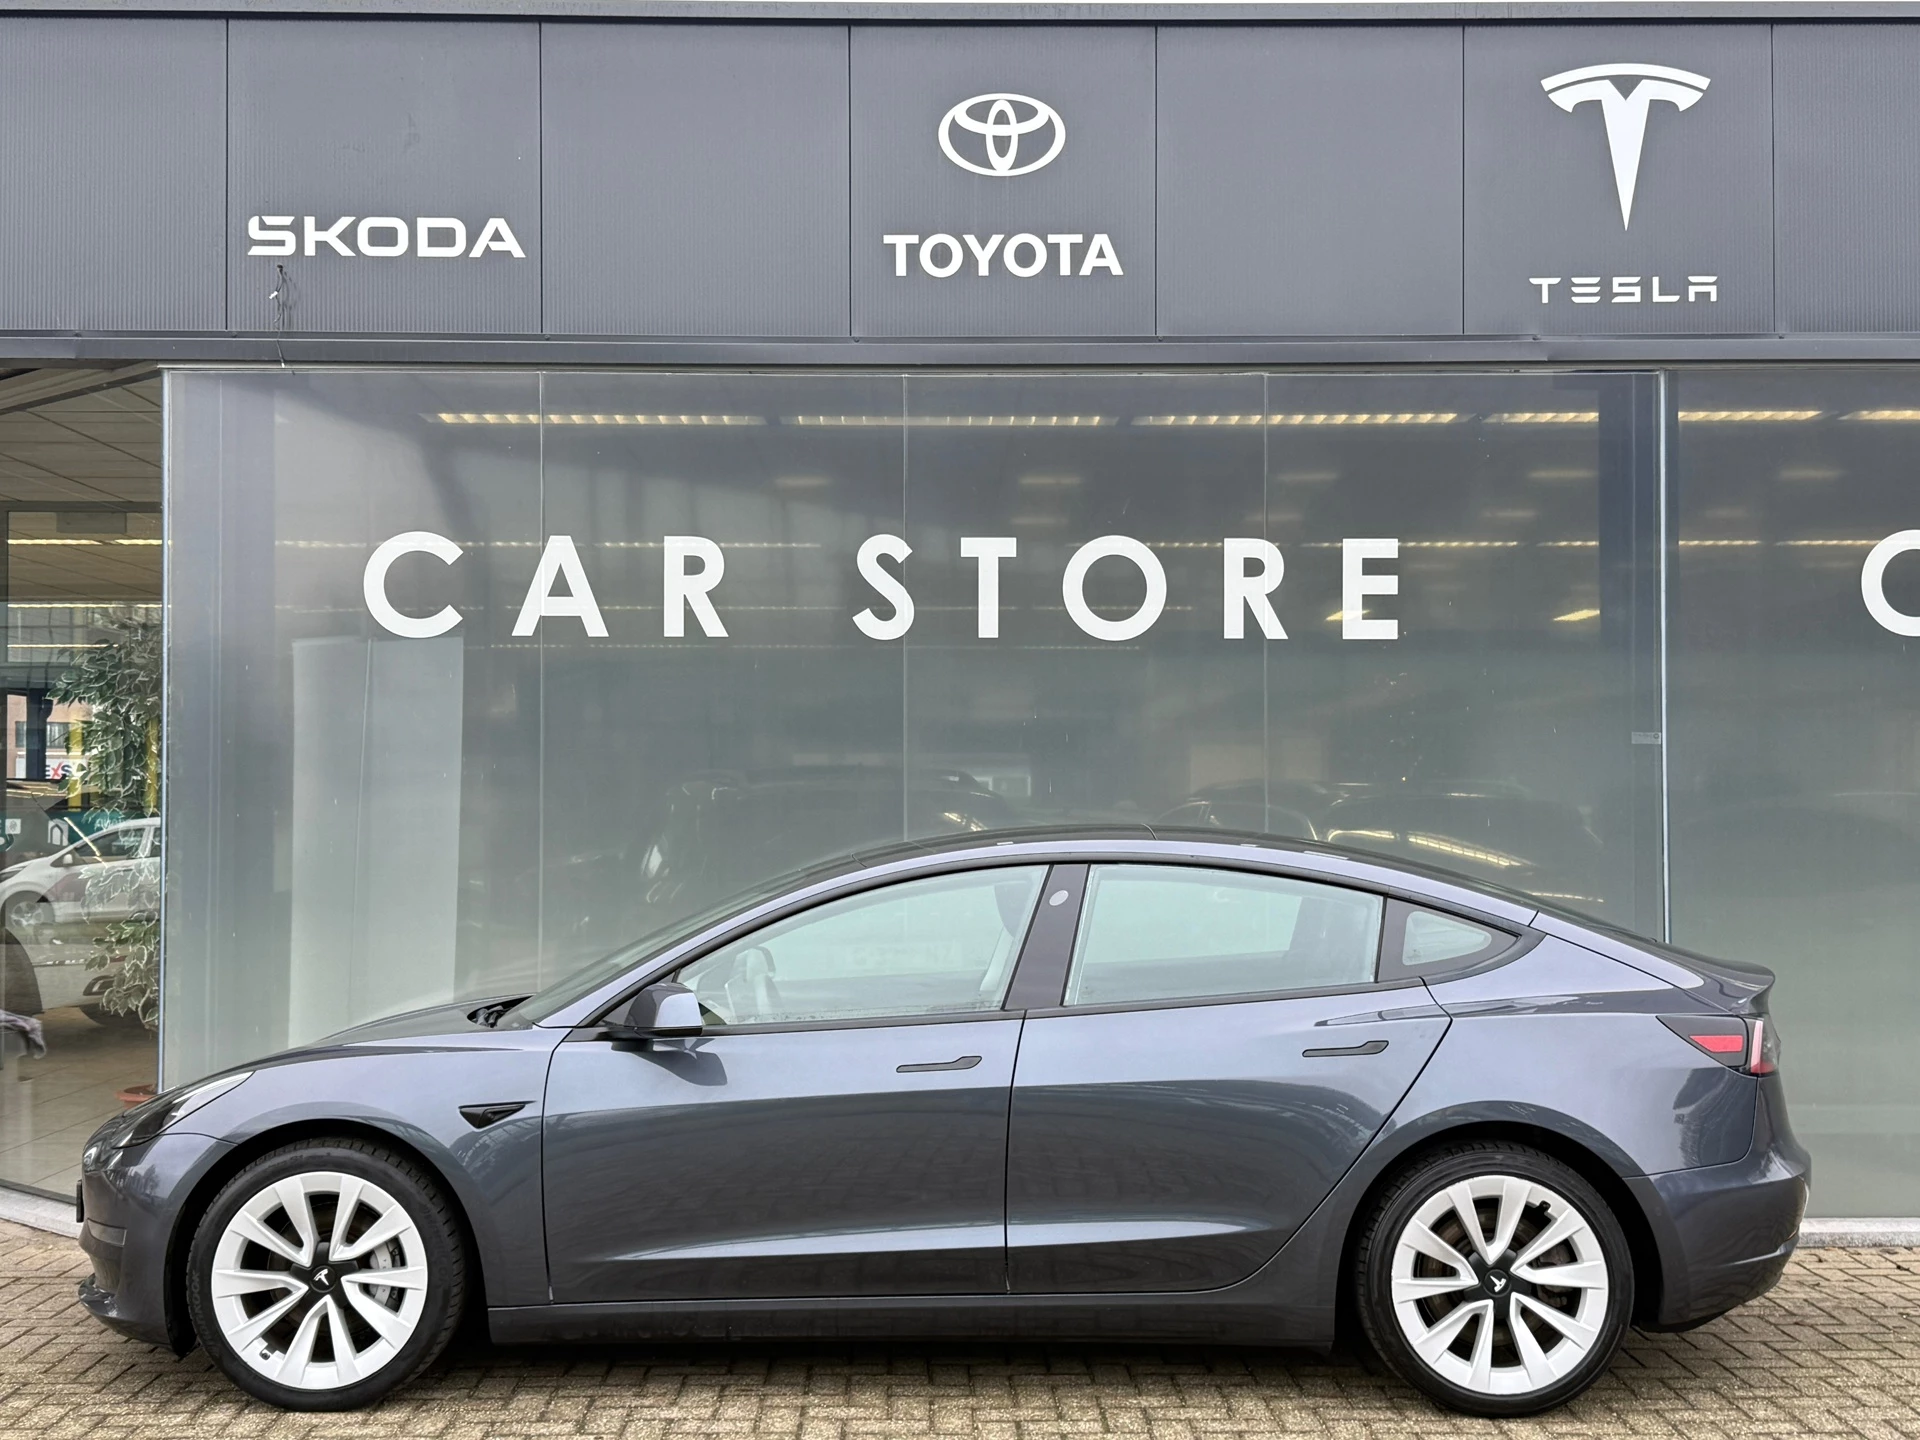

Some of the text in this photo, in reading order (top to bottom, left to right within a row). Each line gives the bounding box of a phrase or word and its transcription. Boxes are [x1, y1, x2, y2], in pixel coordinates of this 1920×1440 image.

[883, 233, 1124, 278] TOYOTA
[1529, 276, 1718, 304] TESLA
[364, 532, 1399, 641] CAR STORE
